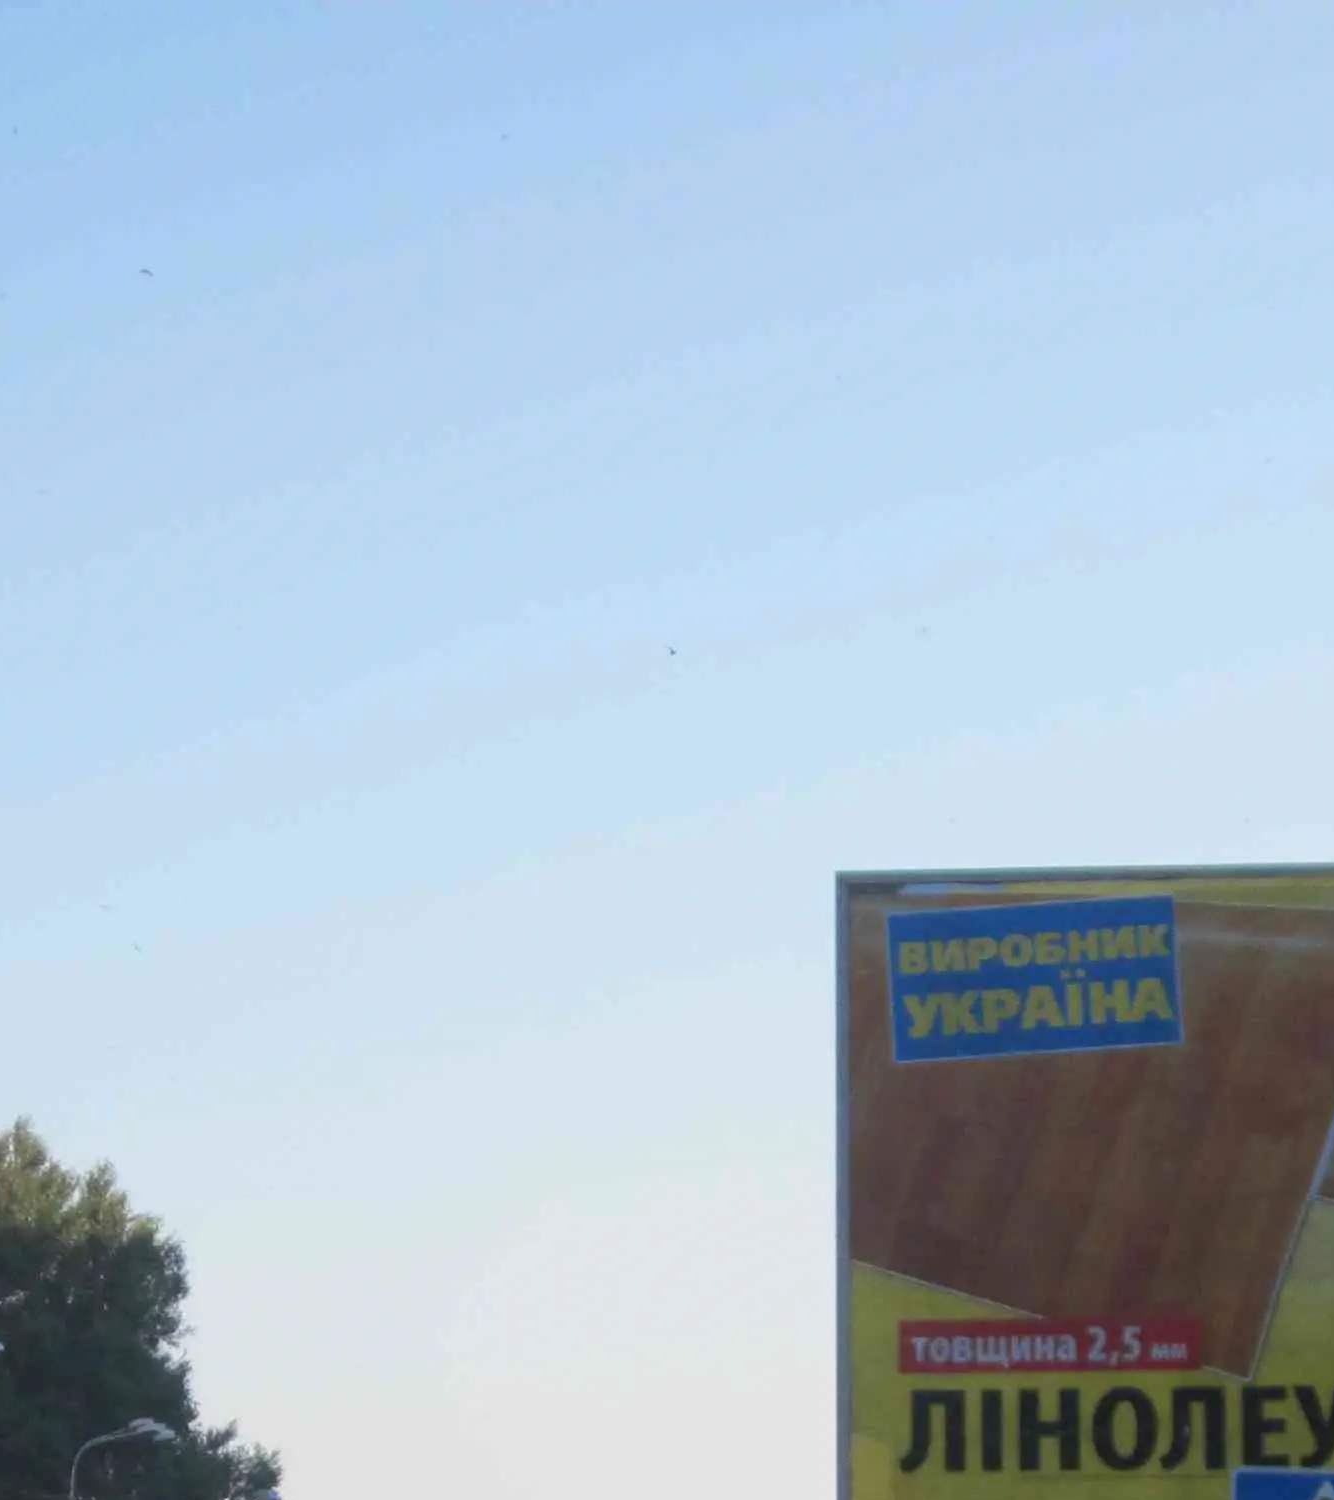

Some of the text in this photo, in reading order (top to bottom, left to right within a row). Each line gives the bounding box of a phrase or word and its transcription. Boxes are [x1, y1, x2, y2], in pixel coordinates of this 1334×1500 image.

[897, 922, 1171, 976] ВИРОБНИК
[902, 970, 1173, 1038] УКРАЇНА
[911, 1336, 1078, 1369] товщина
[1086, 1326, 1142, 1367] 2,5
